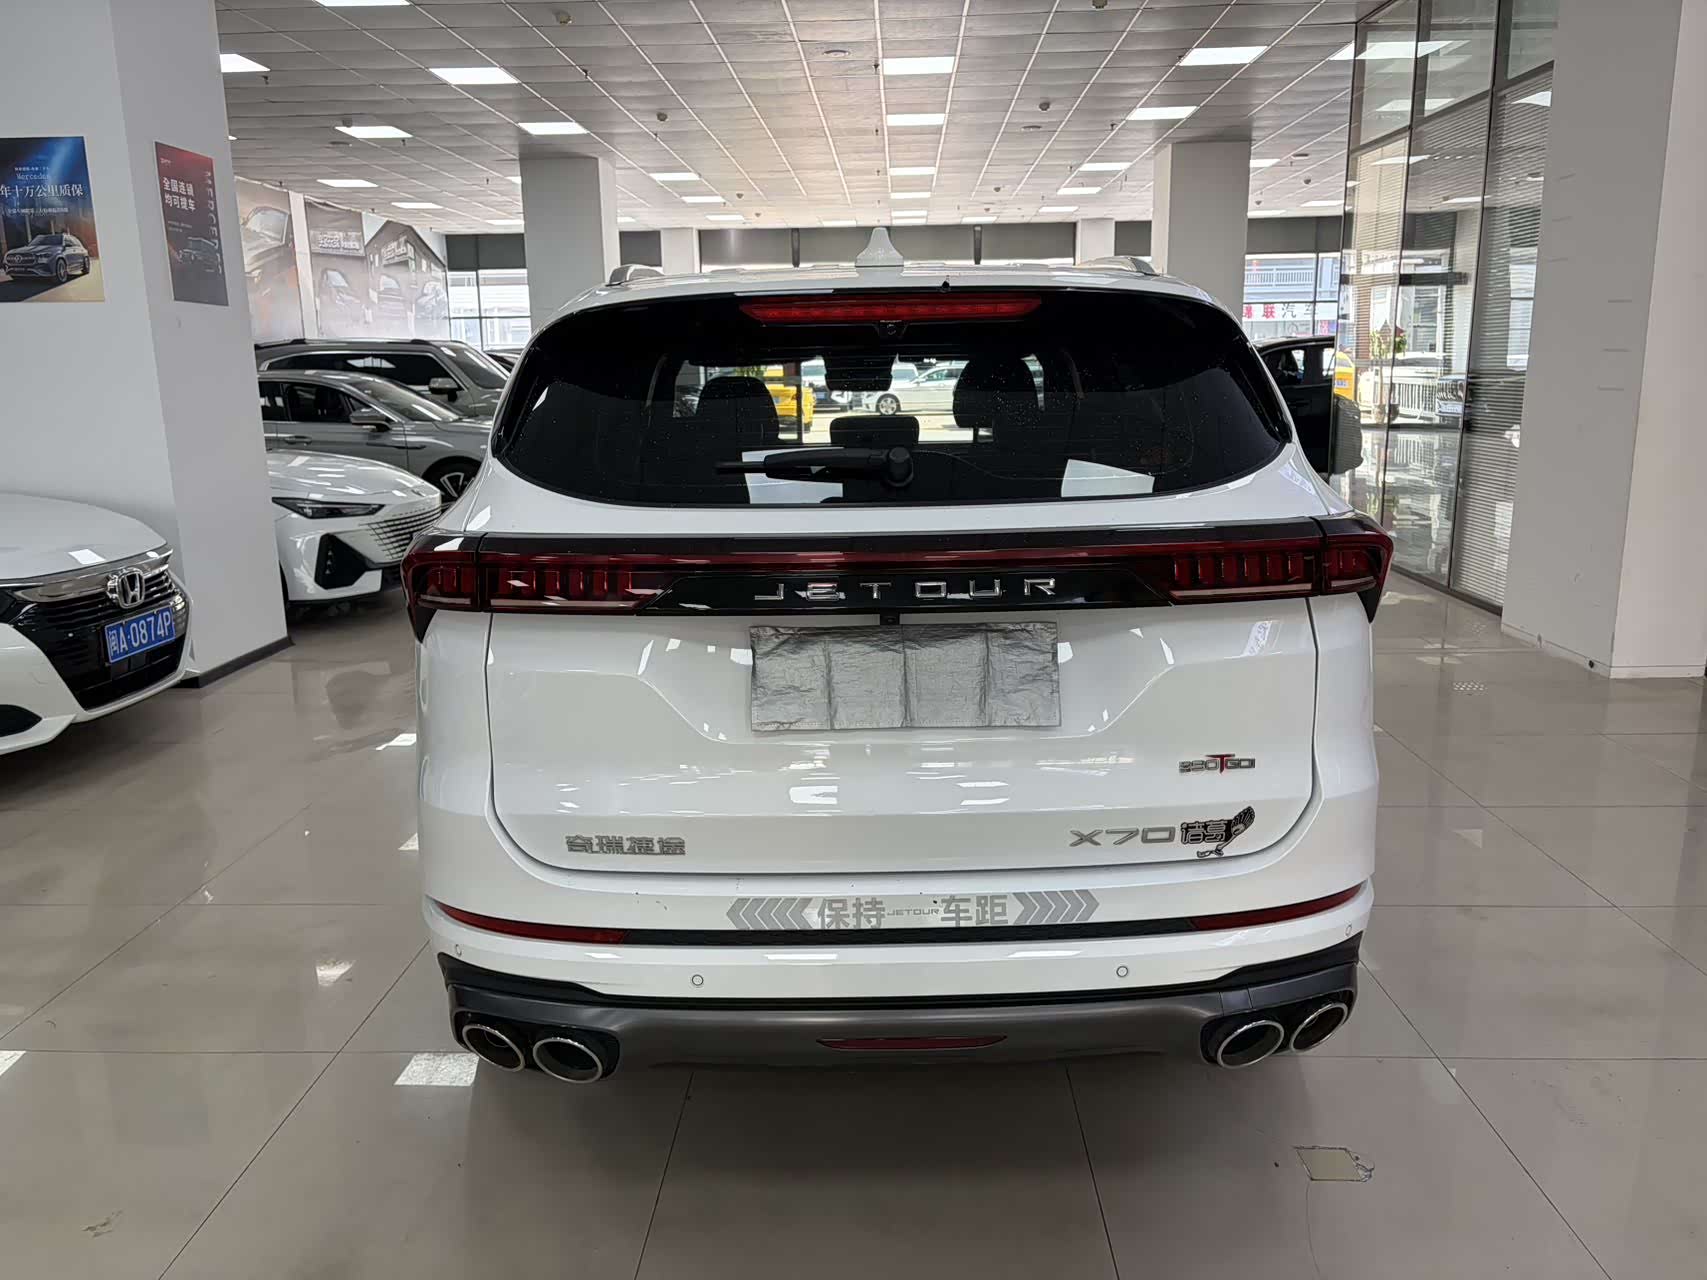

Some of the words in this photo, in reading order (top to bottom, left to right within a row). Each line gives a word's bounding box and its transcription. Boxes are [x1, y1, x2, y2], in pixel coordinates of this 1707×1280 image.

[754, 578, 1056, 601] JETOUR
[565, 834, 686, 856] 奇瑞捷途
[1069, 827, 1176, 847] X70
[817, 896, 886, 929] 保持
[887, 907, 940, 916] JETOUR
[940, 893, 1009, 928] 车距
